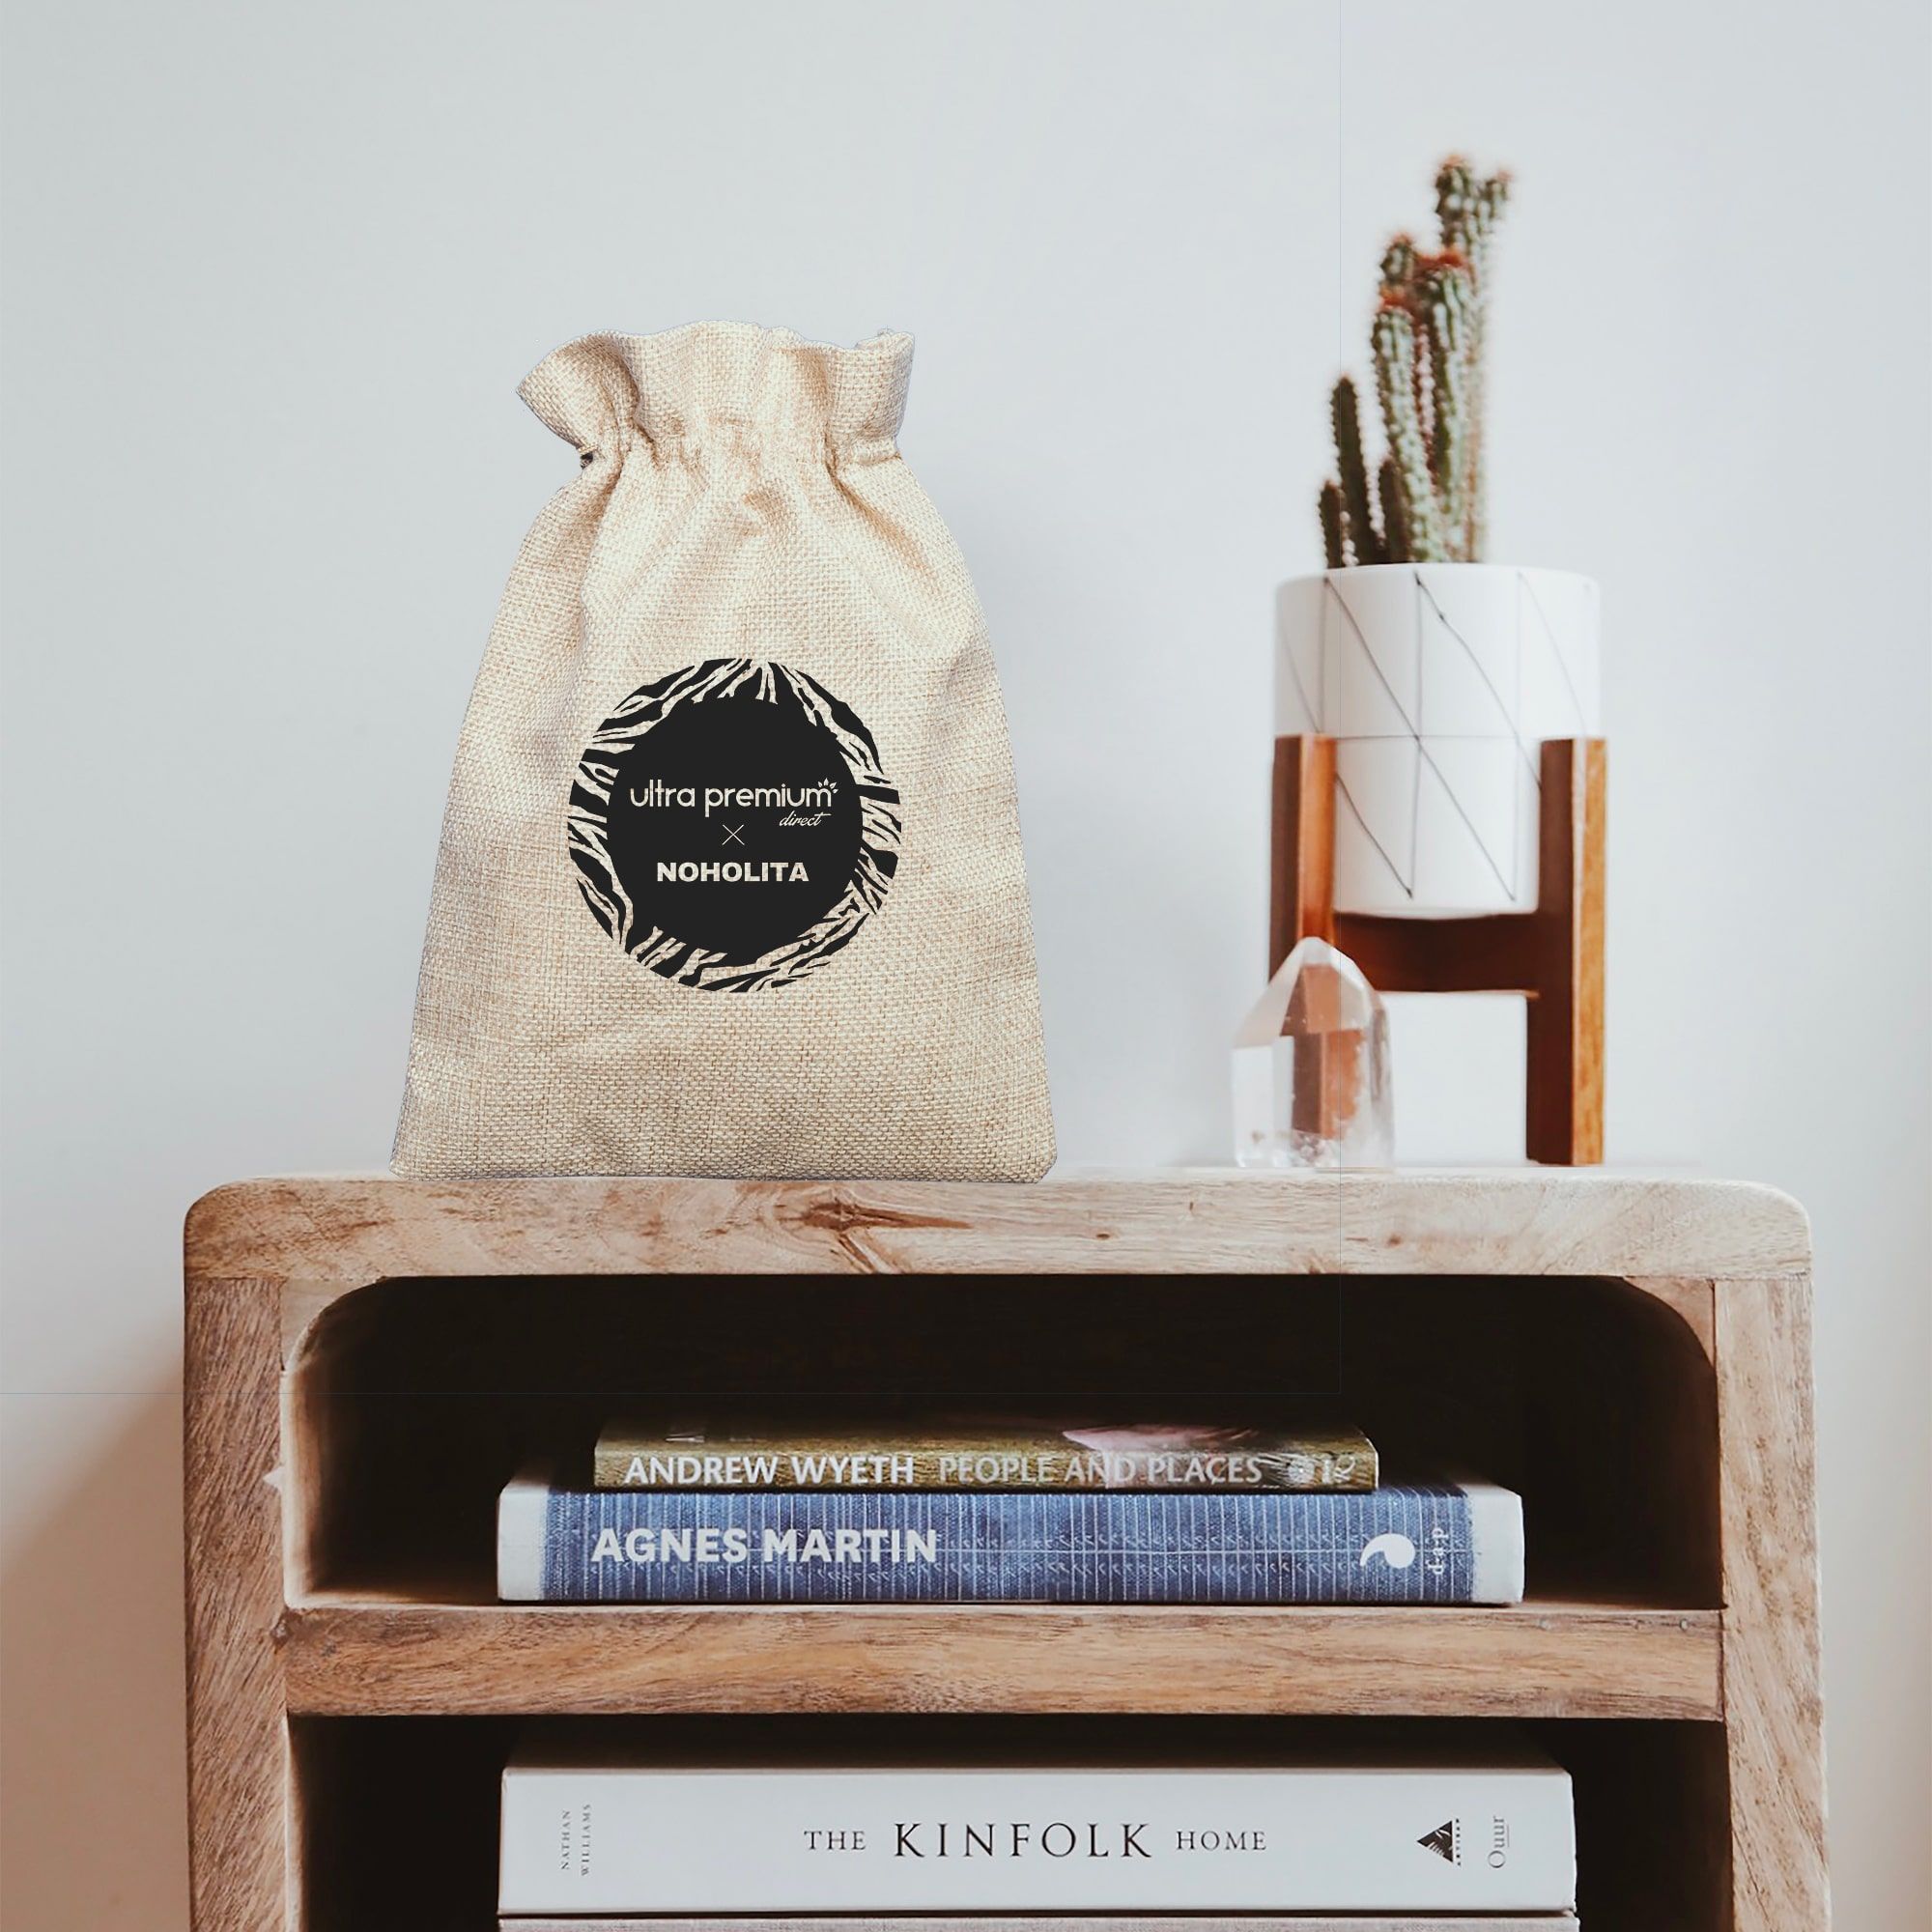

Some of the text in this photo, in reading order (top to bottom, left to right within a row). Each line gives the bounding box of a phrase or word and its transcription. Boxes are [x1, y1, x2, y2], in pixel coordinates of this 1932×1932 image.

[630, 779, 832, 817] ultra premium
[779, 810, 832, 827] direct
[657, 862, 810, 882] NOHOLITA
[624, 1456, 778, 1484] ANDREW
[791, 1456, 913, 1484] WYETH
[939, 1456, 1054, 1484] PEOPLE
[1064, 1456, 1136, 1484] AND
[1148, 1456, 1263, 1484] PLACES
[591, 1527, 937, 1563] AGNES MARTIN
[560, 1810, 571, 1870] NATHAN
[581, 1804, 591, 1877] WILLIAMS
[804, 1822, 1266, 1859] THE KINFOLK HOME
[1488, 1815, 1506, 1869] Ouur
